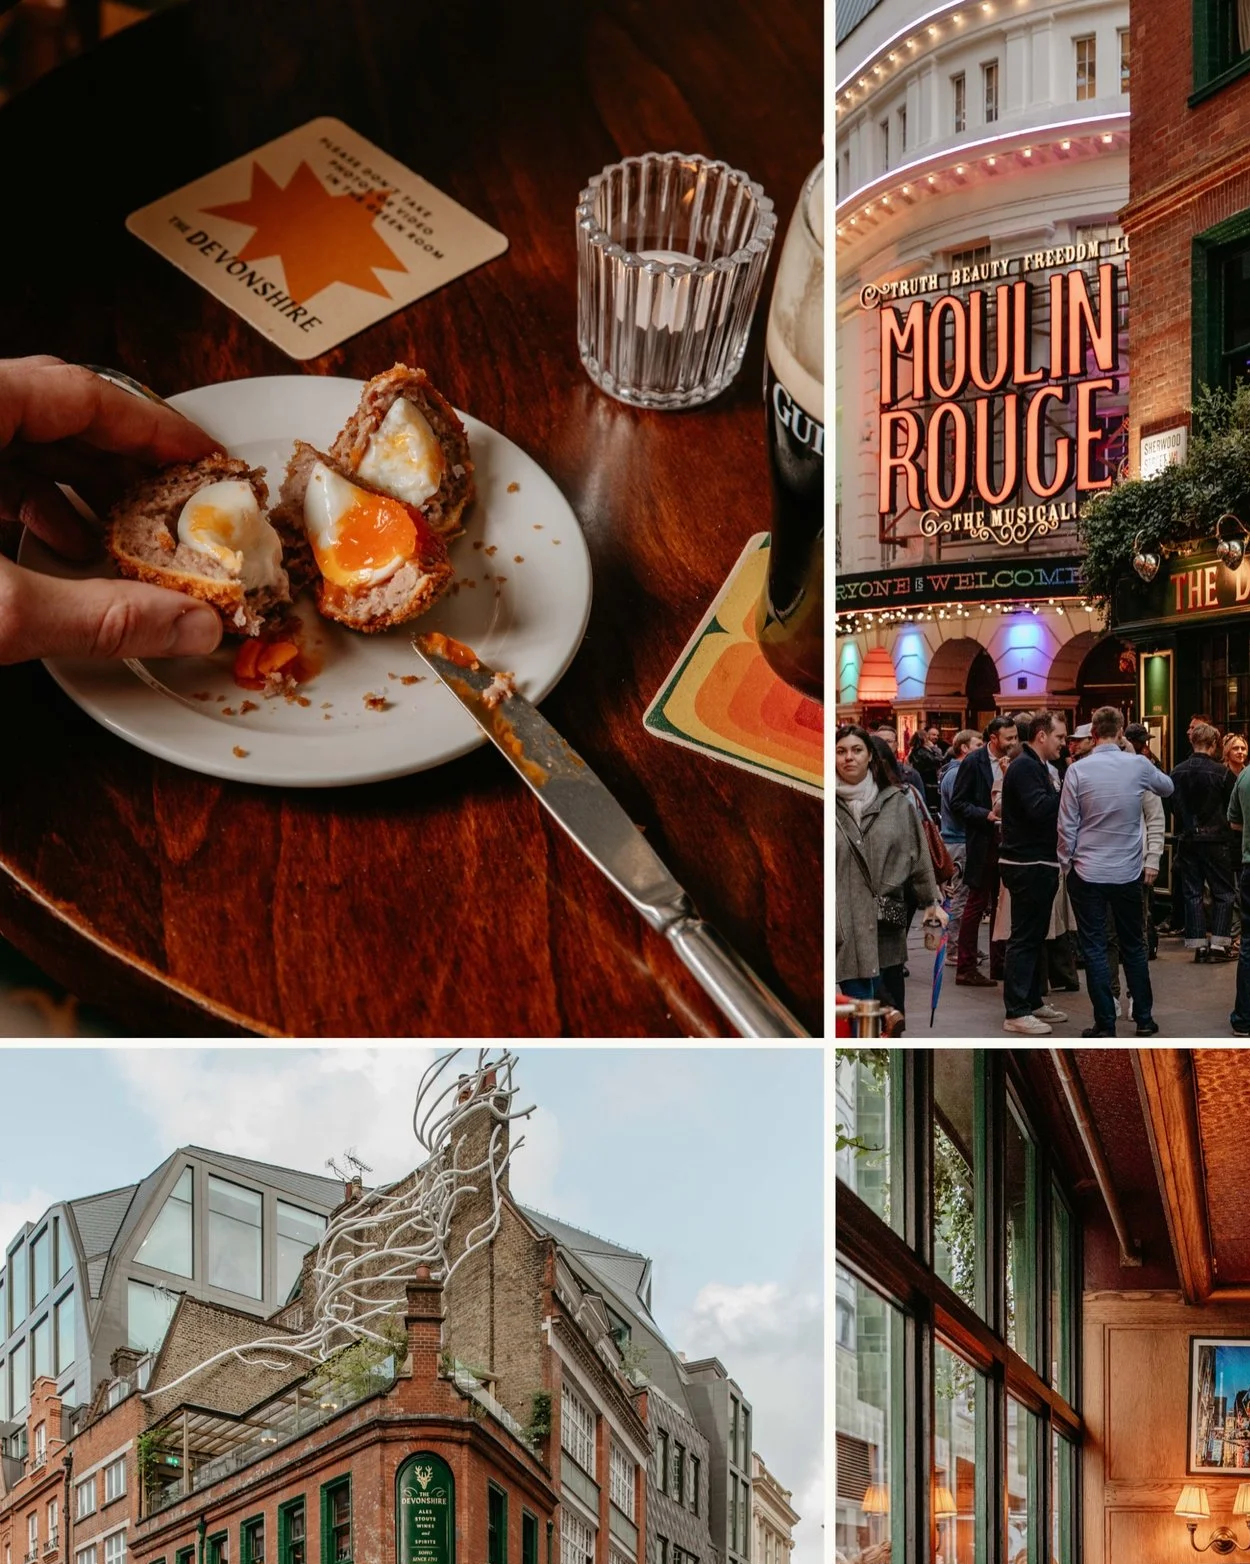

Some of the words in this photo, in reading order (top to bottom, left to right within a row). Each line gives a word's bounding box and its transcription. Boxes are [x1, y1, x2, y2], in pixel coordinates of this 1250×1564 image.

[407, 231, 444, 261] ROOM
[185, 229, 323, 333] DEVONSHIRE
[890, 273, 939, 299] TRUTH
[951, 258, 1010, 287] BEAUTY
[1023, 240, 1100, 272] FREEDOM
[879, 263, 1117, 405] MOULIN
[878, 378, 1114, 514] ROUGE
[1144, 433, 1181, 456] SHERWOOD
[952, 511, 985, 531] THE
[990, 501, 1077, 527] MUSICAL!
[914, 577, 924, 592] IS
[926, 567, 1087, 591] WELCOME
[1170, 565, 1219, 613] THE
[401, 1497, 447, 1505] DEVONSHIRE
